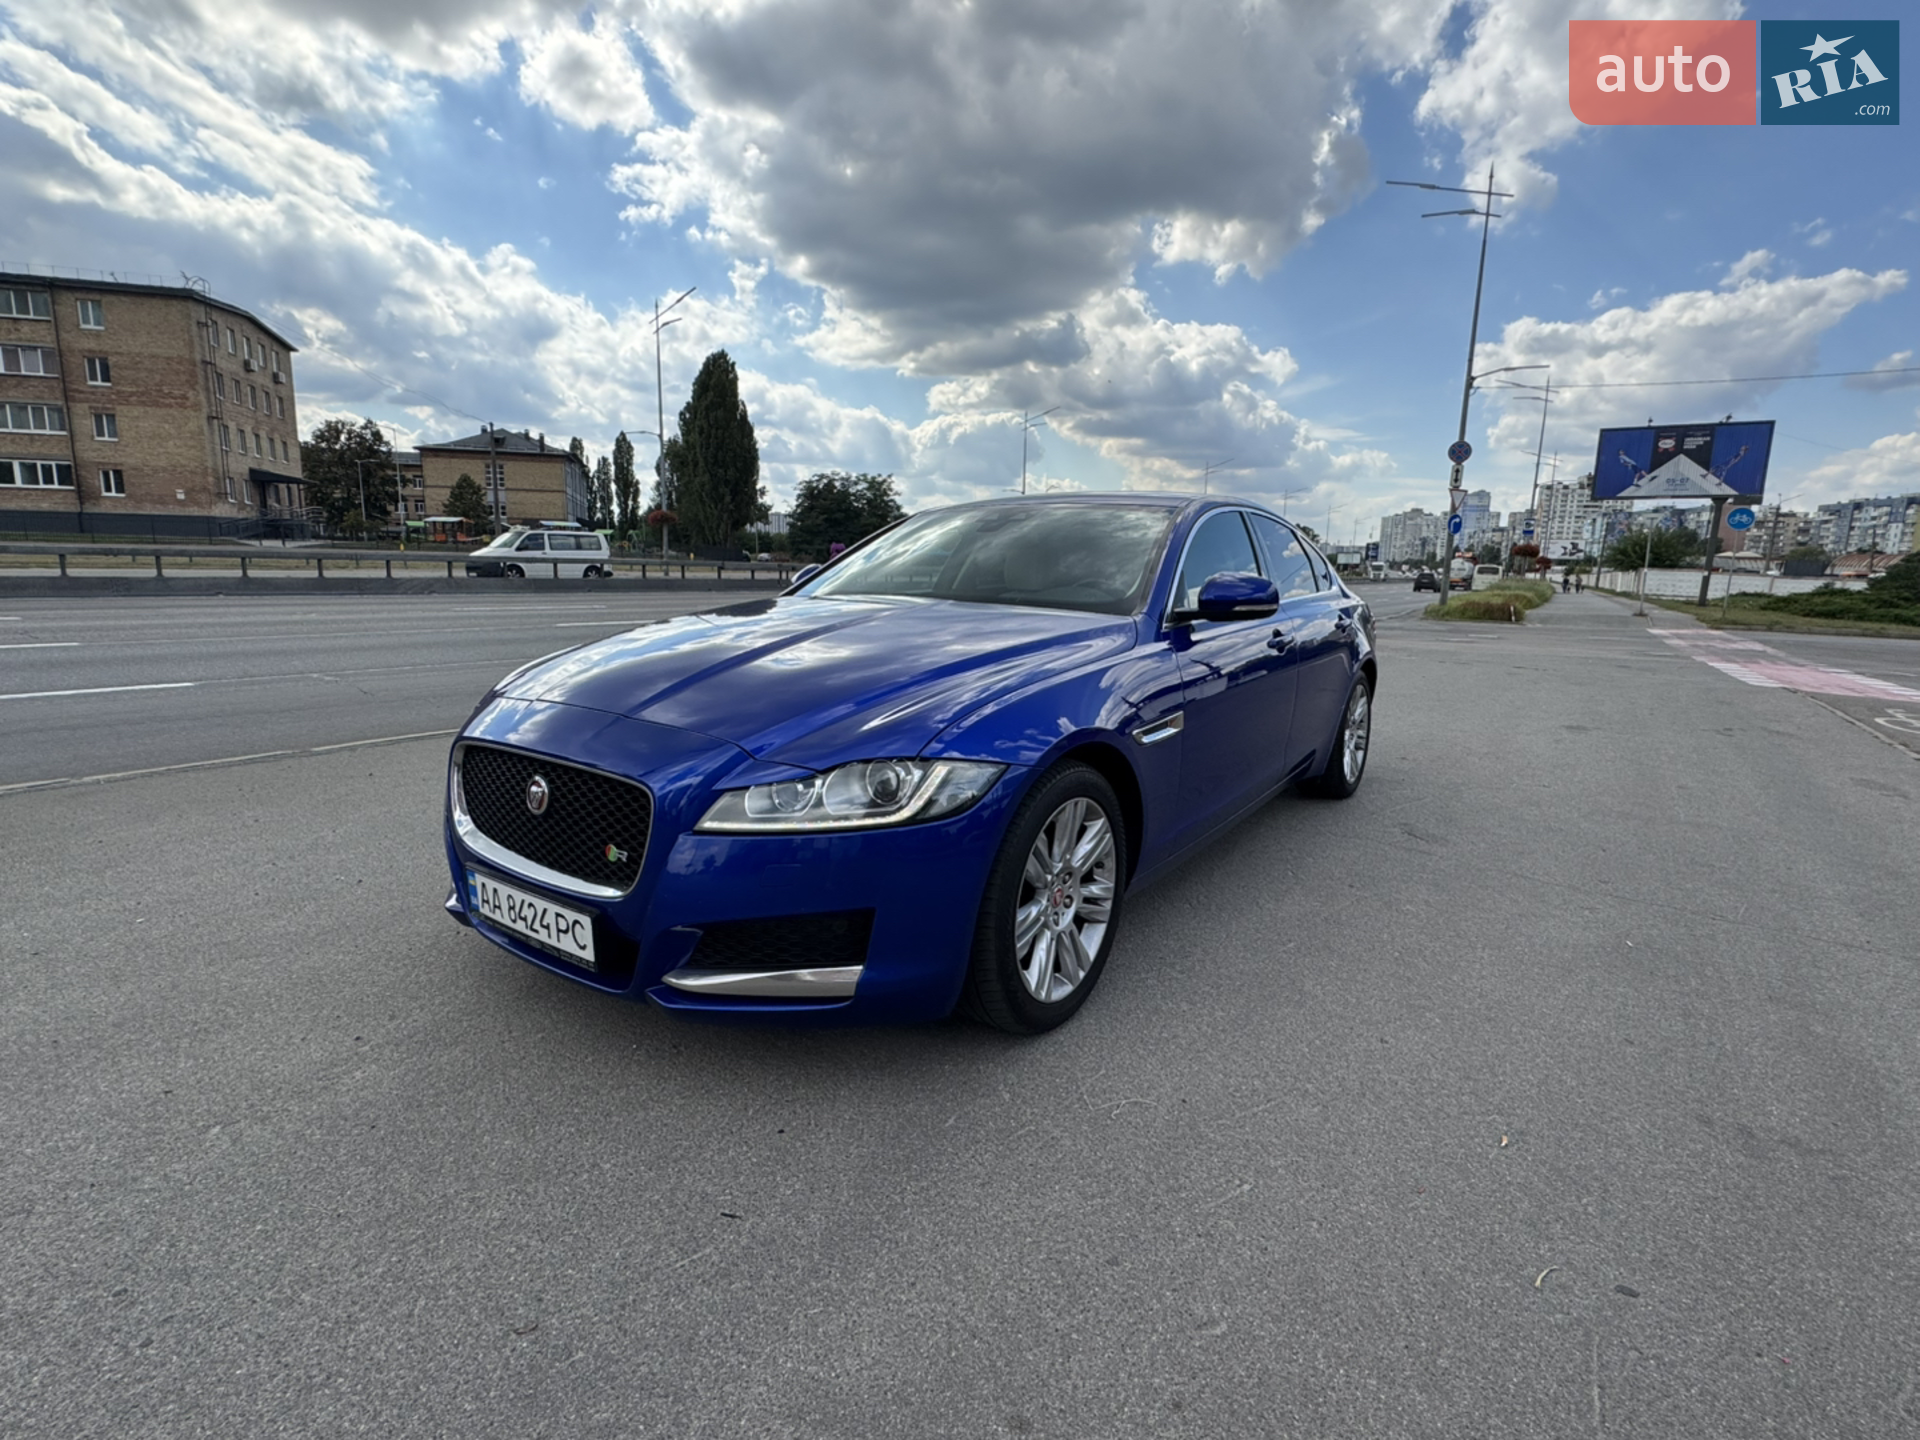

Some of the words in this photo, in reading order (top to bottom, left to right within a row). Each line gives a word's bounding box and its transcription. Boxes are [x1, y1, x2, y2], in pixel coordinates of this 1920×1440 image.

[481, 882, 504, 919] AA
[506, 894, 552, 939] 8424
[554, 911, 587, 951] PC
